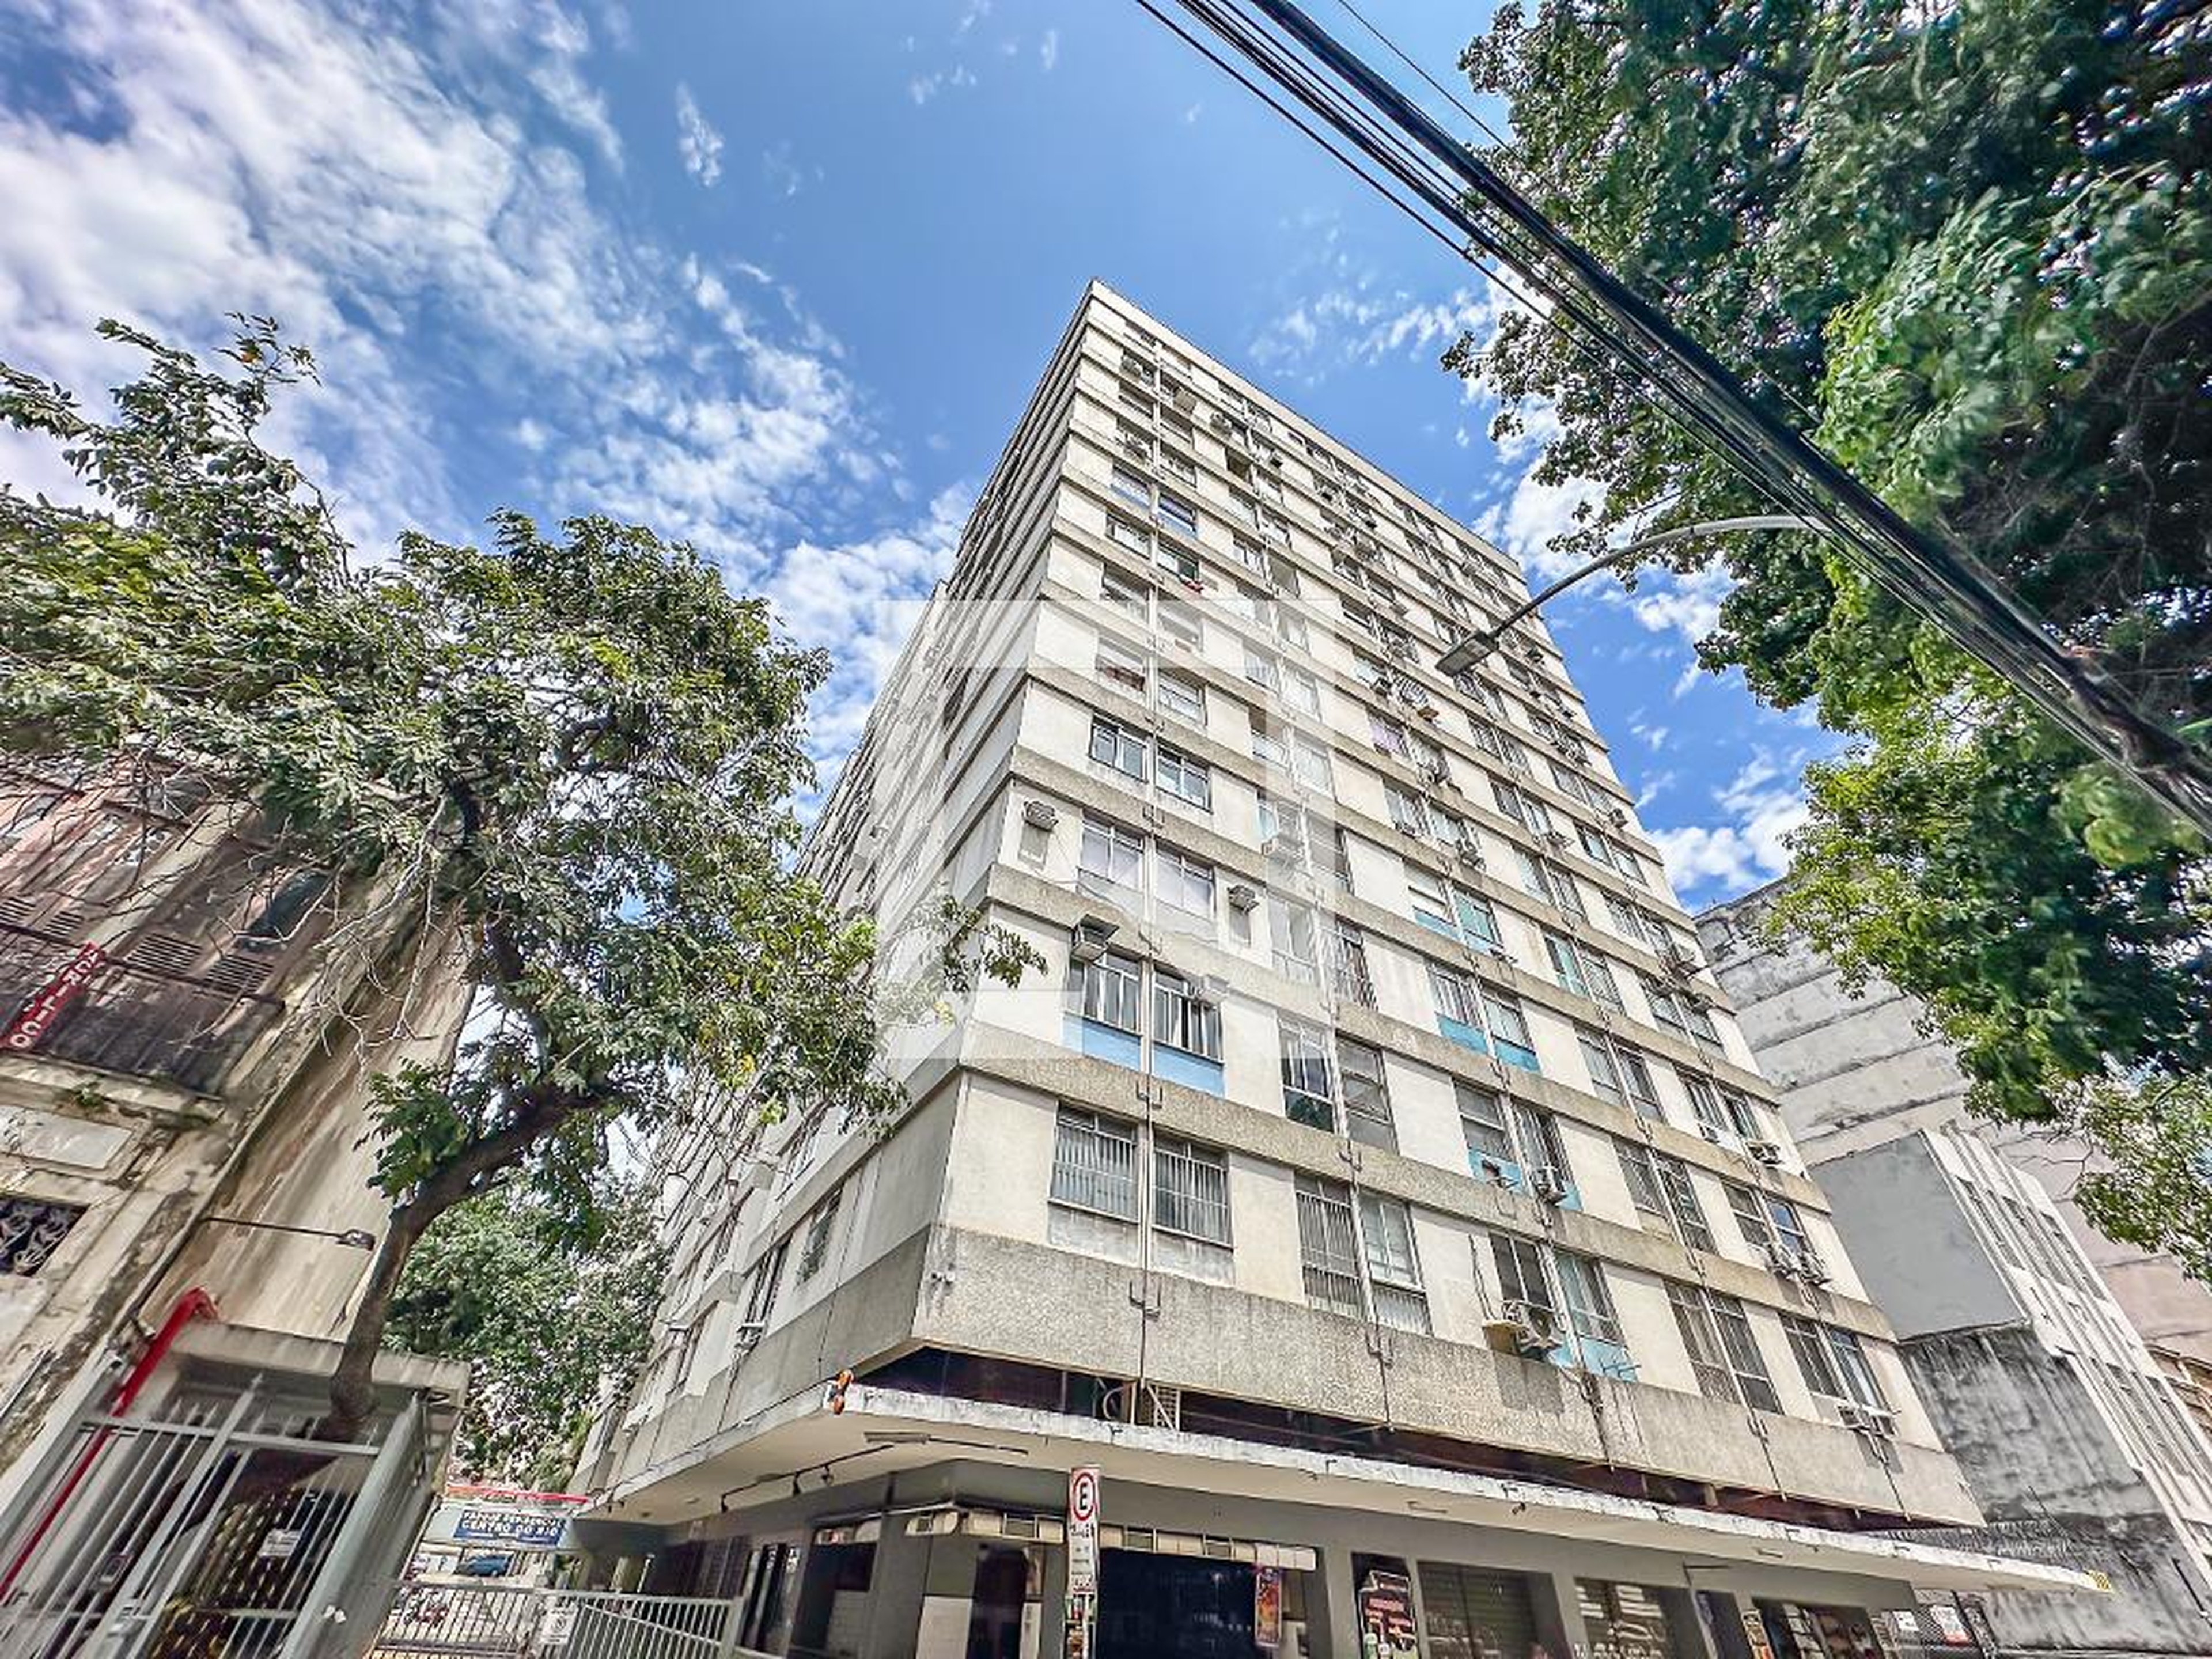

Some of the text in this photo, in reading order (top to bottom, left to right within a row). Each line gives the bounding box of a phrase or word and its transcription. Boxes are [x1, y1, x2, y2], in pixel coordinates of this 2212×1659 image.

[1080, 1482, 1088, 1510] E
[461, 1521, 558, 1536] CENTRO DO RIO
